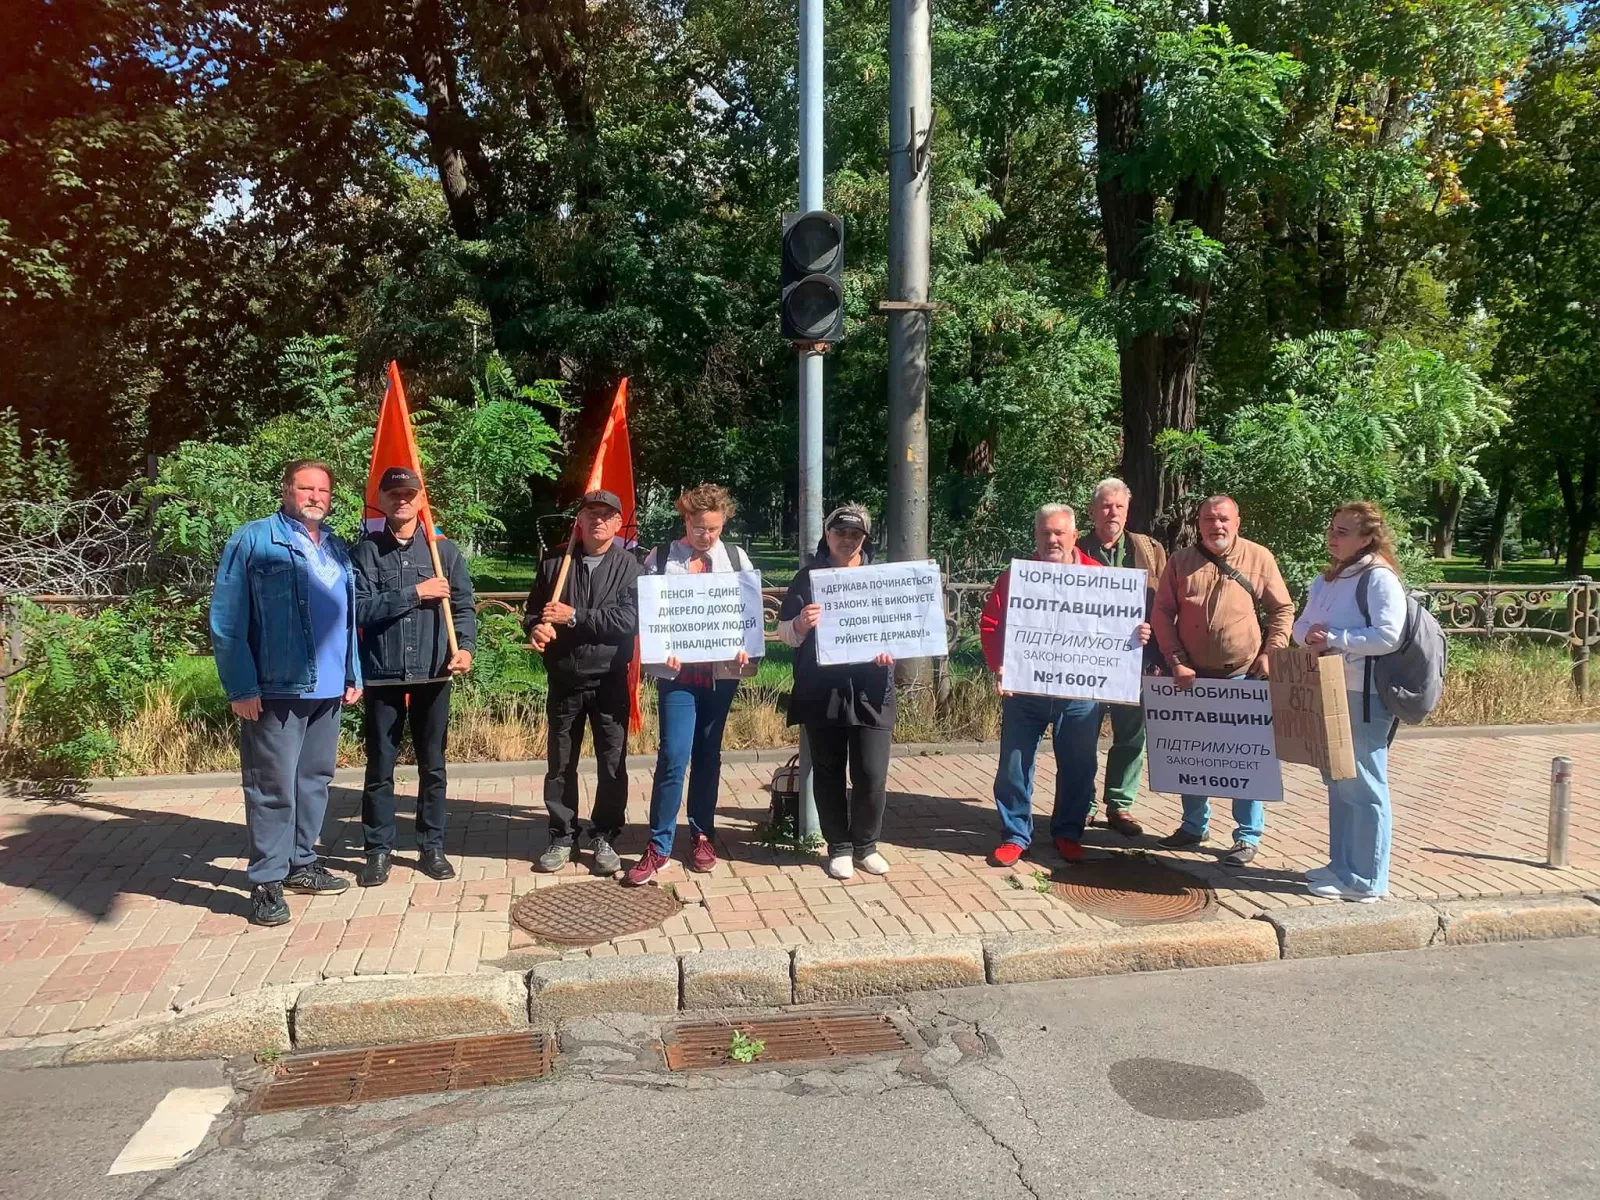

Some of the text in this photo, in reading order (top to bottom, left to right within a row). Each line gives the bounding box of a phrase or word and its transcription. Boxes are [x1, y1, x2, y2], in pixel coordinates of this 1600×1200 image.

[821, 575, 933, 595] «ДЕРЖАВА ПОЧИНАЄТЬСЯ
[1019, 570, 1137, 592] ЧОРНОБИЛЬЦІ
[660, 589, 694, 599] ПЕНСІЯ
[708, 587, 740, 598] ЄДИНЕ
[824, 593, 935, 611] ІЗ ЗАКОНУ. НЕ ВИКОНУЄТЕ
[658, 603, 746, 618] ДЖЕРЕЛО ДОХОДУ
[1009, 596, 1142, 619] ПОЛТАВЩИНИ
[648, 616, 757, 634] ТЯЖКОХВОРИХ ЛЮДЕЙ
[839, 615, 870, 628] СУДОВІ
[872, 612, 912, 624] РІШЕННЯ
[665, 637, 745, 651] З ІНВАЛІДНІСТЮ!
[835, 629, 931, 645] РУЙНУЄТЕ ДЕРЖАВУ!»
[1014, 630, 1133, 652] ПІДТРИМУЮТЬ
[1023, 650, 1121, 668] ЗАКОНОПРОЕКТ
[1033, 670, 1108, 688] №16007
[1151, 684, 1268, 702] ЧОРНОБИЛЬЦІ
[1146, 708, 1273, 727] ПОЛТАВЩИНИ
[1155, 737, 1271, 756] ПІДТРИМУЮТЬ
[1166, 755, 1261, 771] ЗАКОНОПРОЕКТ
[1178, 773, 1250, 790] №16007
